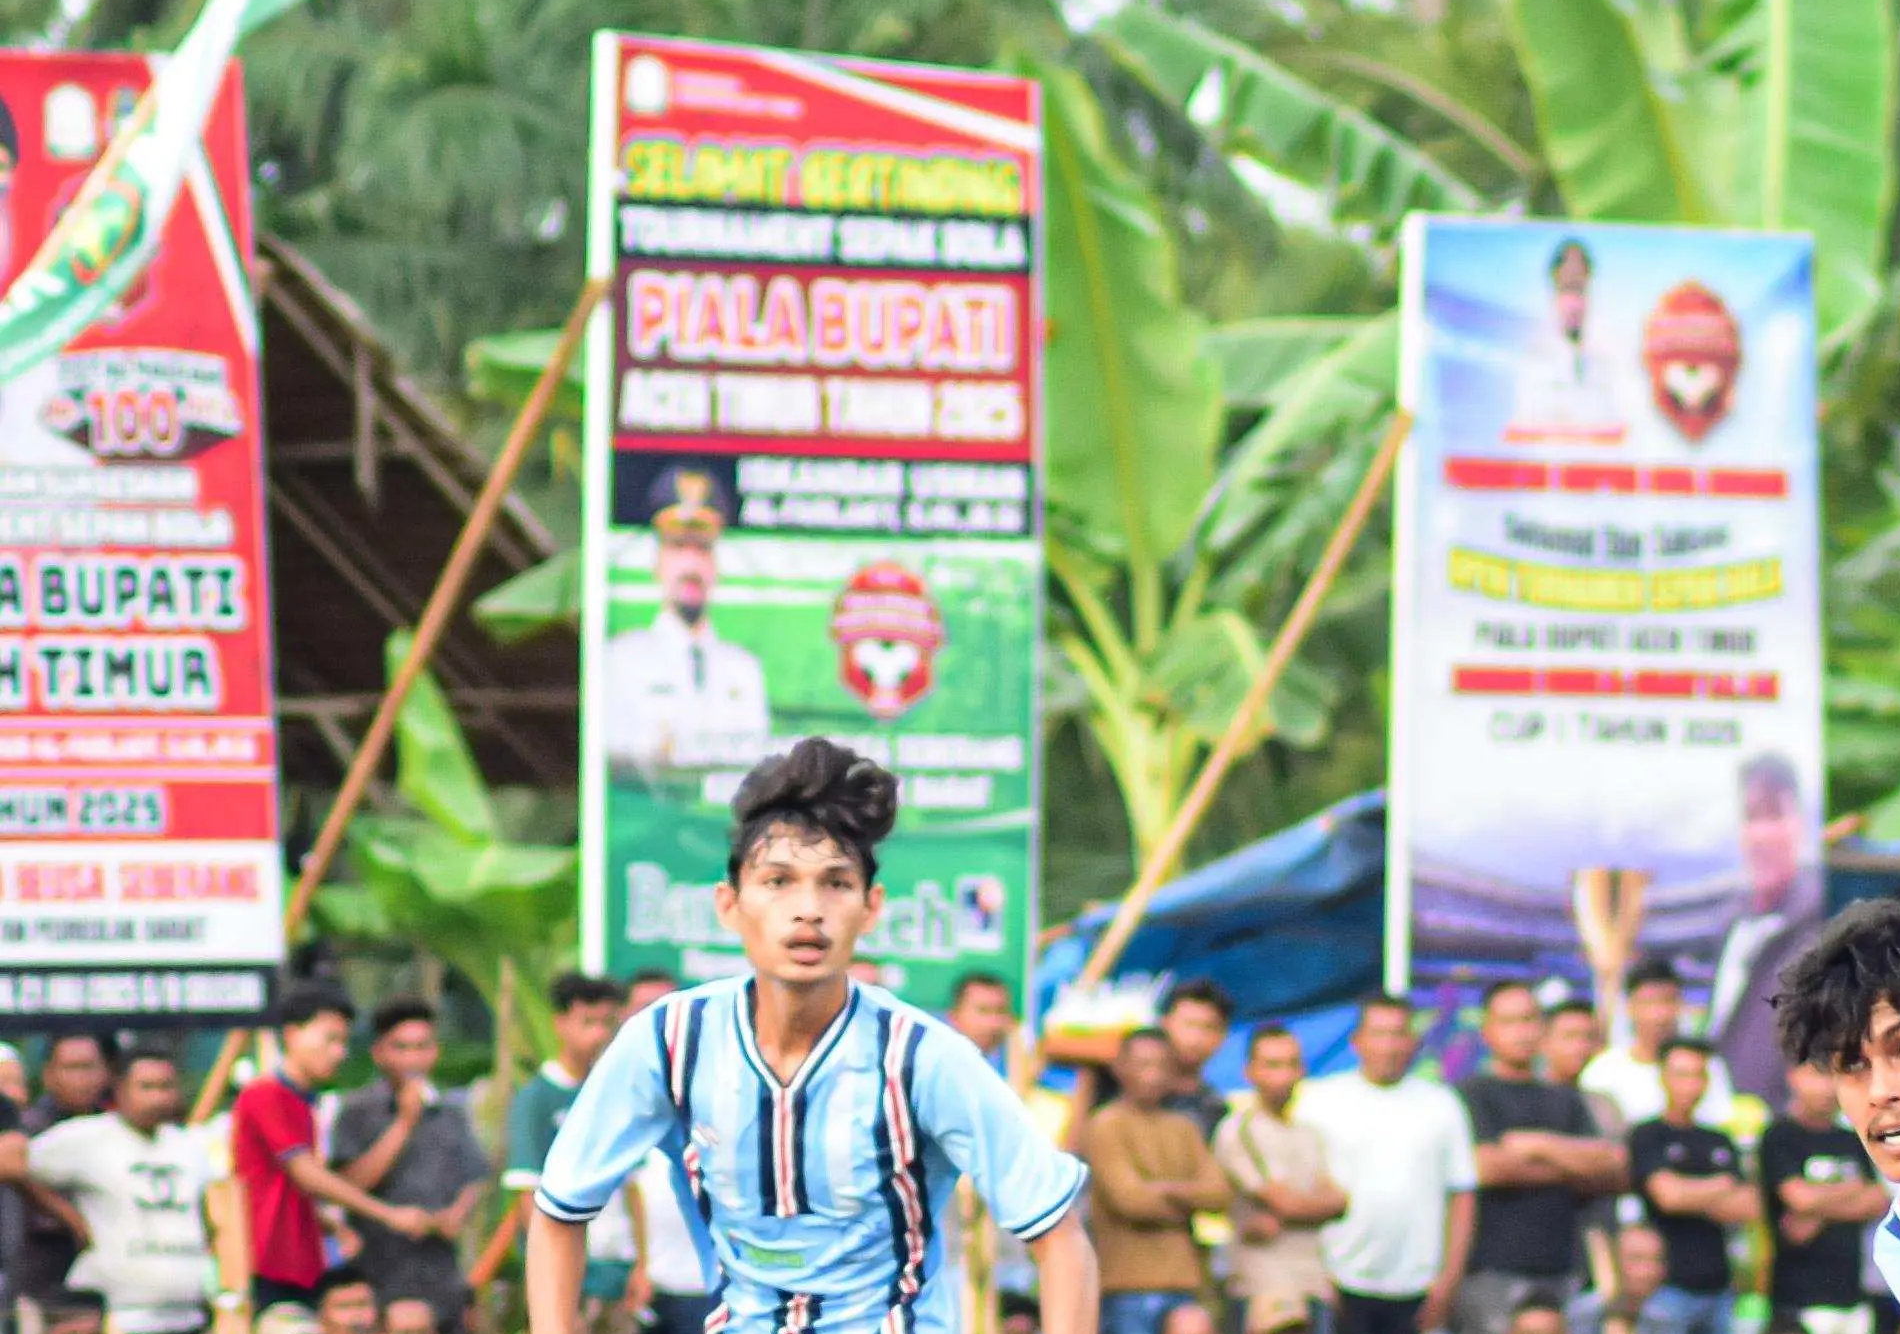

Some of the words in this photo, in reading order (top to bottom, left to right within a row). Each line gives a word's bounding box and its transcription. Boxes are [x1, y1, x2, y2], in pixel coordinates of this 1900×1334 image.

[632, 275, 804, 360] PIALA
[812, 281, 1016, 369] BUPATI
[90, 391, 178, 454] 100
[38, 564, 237, 618] BUPATI
[38, 645, 215, 699] TIMUR
[78, 790, 164, 827] 2025
